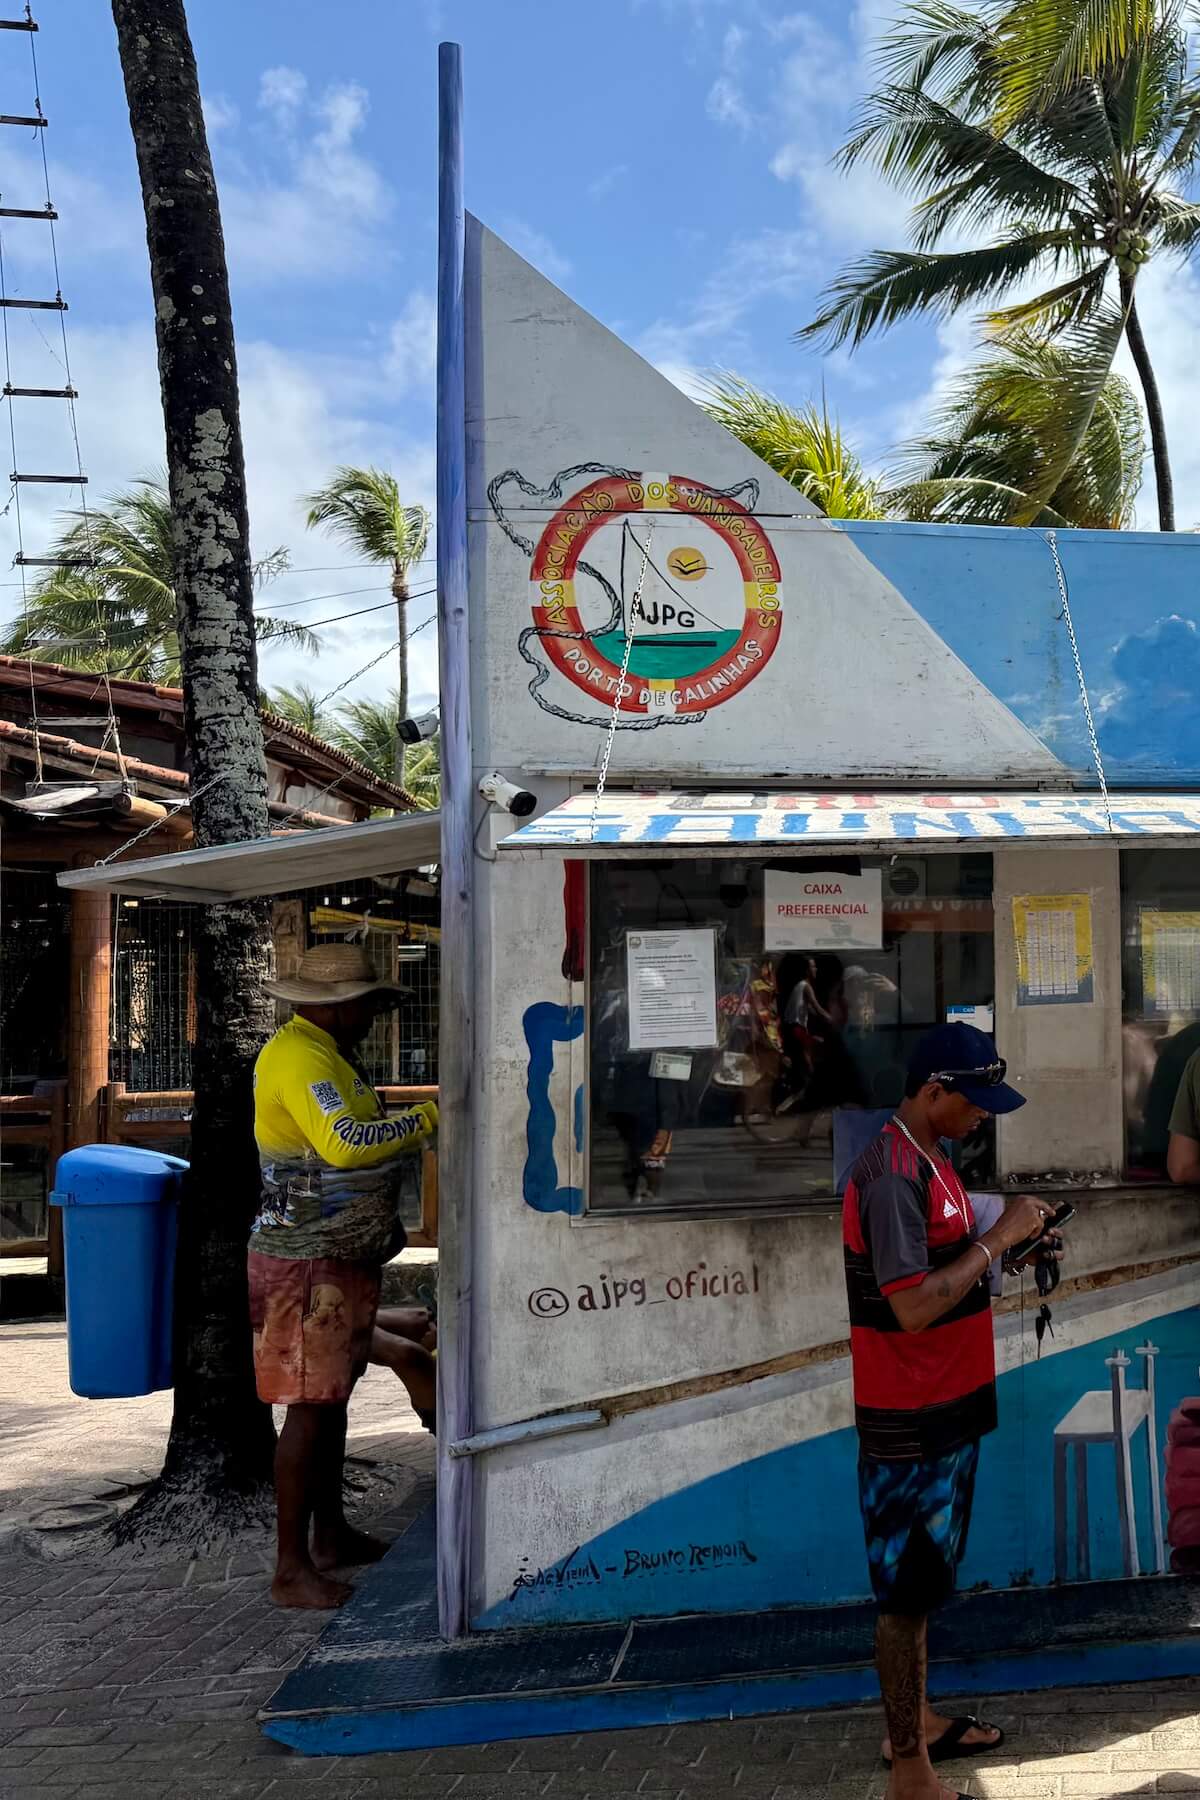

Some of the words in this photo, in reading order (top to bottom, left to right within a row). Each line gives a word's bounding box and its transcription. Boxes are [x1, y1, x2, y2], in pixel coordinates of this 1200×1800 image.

[625, 481, 680, 505] DOS
[687, 490, 781, 630] JANGADEIROS
[630, 591, 696, 628] AJPG
[563, 646, 633, 700] PORTO
[638, 690, 667, 707] DE
[669, 639, 764, 706] GALINHAS
[777, 903, 869, 916] PREFERENCIAL
[803, 883, 843, 895] CAIXA
[528, 1262, 761, 1318] @ajpg_oficial
